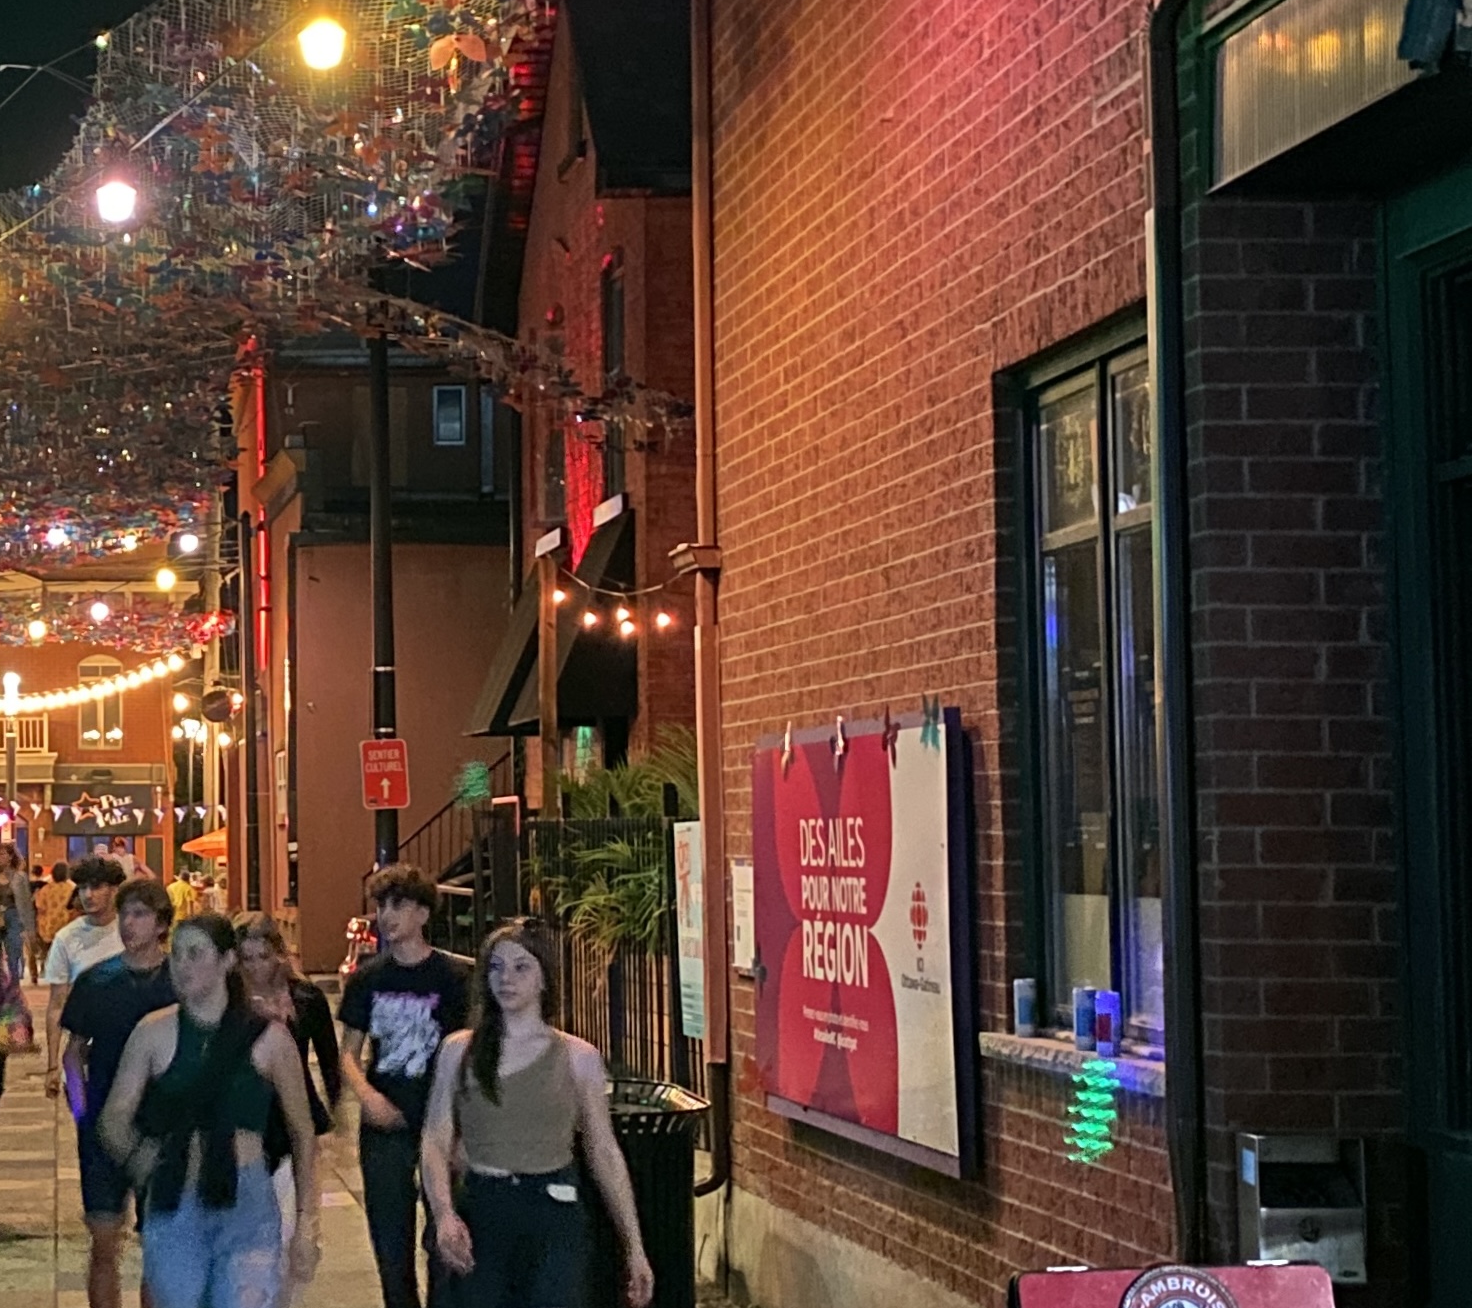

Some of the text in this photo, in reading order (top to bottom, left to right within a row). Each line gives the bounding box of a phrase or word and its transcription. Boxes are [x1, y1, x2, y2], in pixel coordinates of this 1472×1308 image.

[365, 761, 404, 773] CULTUREL
[368, 748, 400, 762] SENTIER
[799, 816, 866, 868] DES AILES
[801, 875, 868, 914] POUR NOTRE
[802, 912, 869, 989] RÉGION
